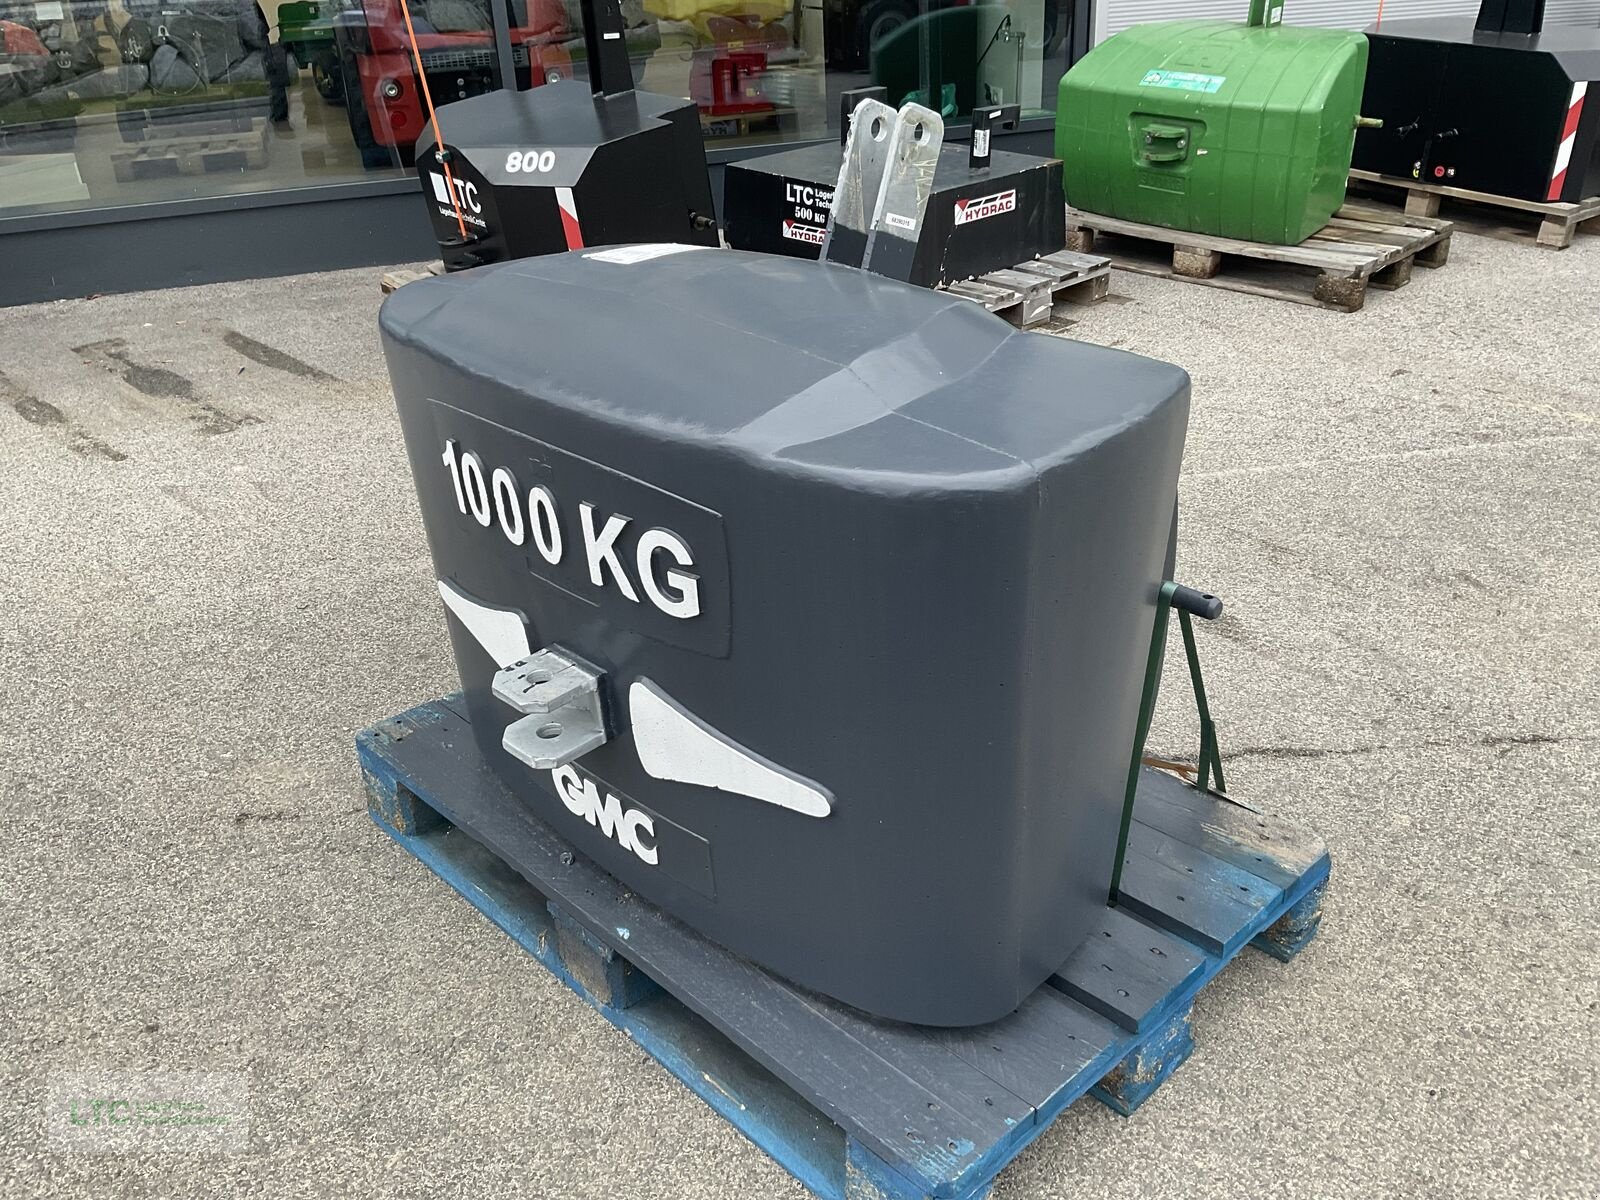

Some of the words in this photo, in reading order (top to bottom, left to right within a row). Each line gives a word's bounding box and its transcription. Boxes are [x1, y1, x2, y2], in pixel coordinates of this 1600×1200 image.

[505, 150, 556, 173] 800
[445, 176, 481, 213] LTC
[786, 183, 814, 205] LTC
[794, 206, 813, 221] 500
[814, 212, 826, 224] KG
[965, 200, 1013, 221] HYDRAC
[441, 438, 563, 566] 1000
[578, 499, 701, 619] KG
[551, 764, 659, 866] GMC
